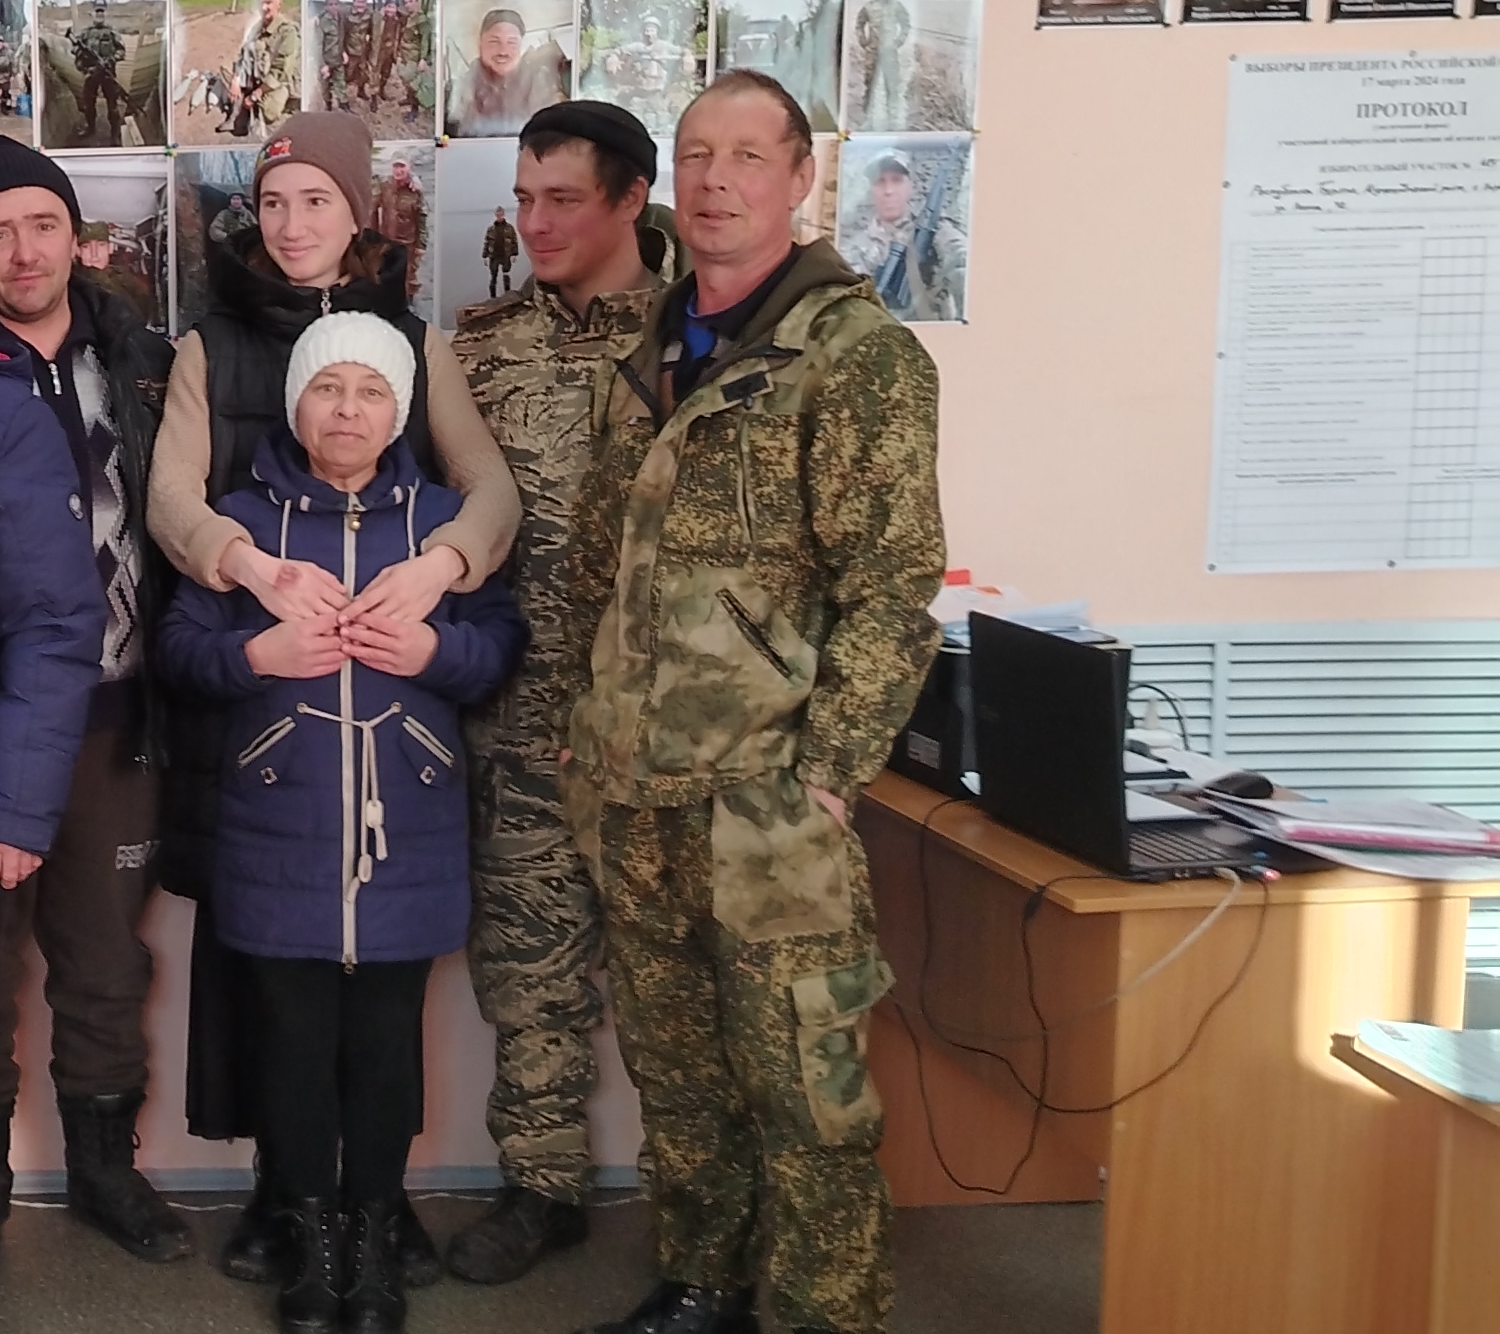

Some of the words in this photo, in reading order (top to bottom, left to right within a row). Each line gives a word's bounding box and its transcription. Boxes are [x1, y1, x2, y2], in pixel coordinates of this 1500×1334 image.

[1244, 61, 1305, 73] ВЫБОРЫ
[1309, 58, 1397, 72] ПРЕЗИДЕНТА
[1356, 101, 1468, 119] ПРОТОКОЛ
